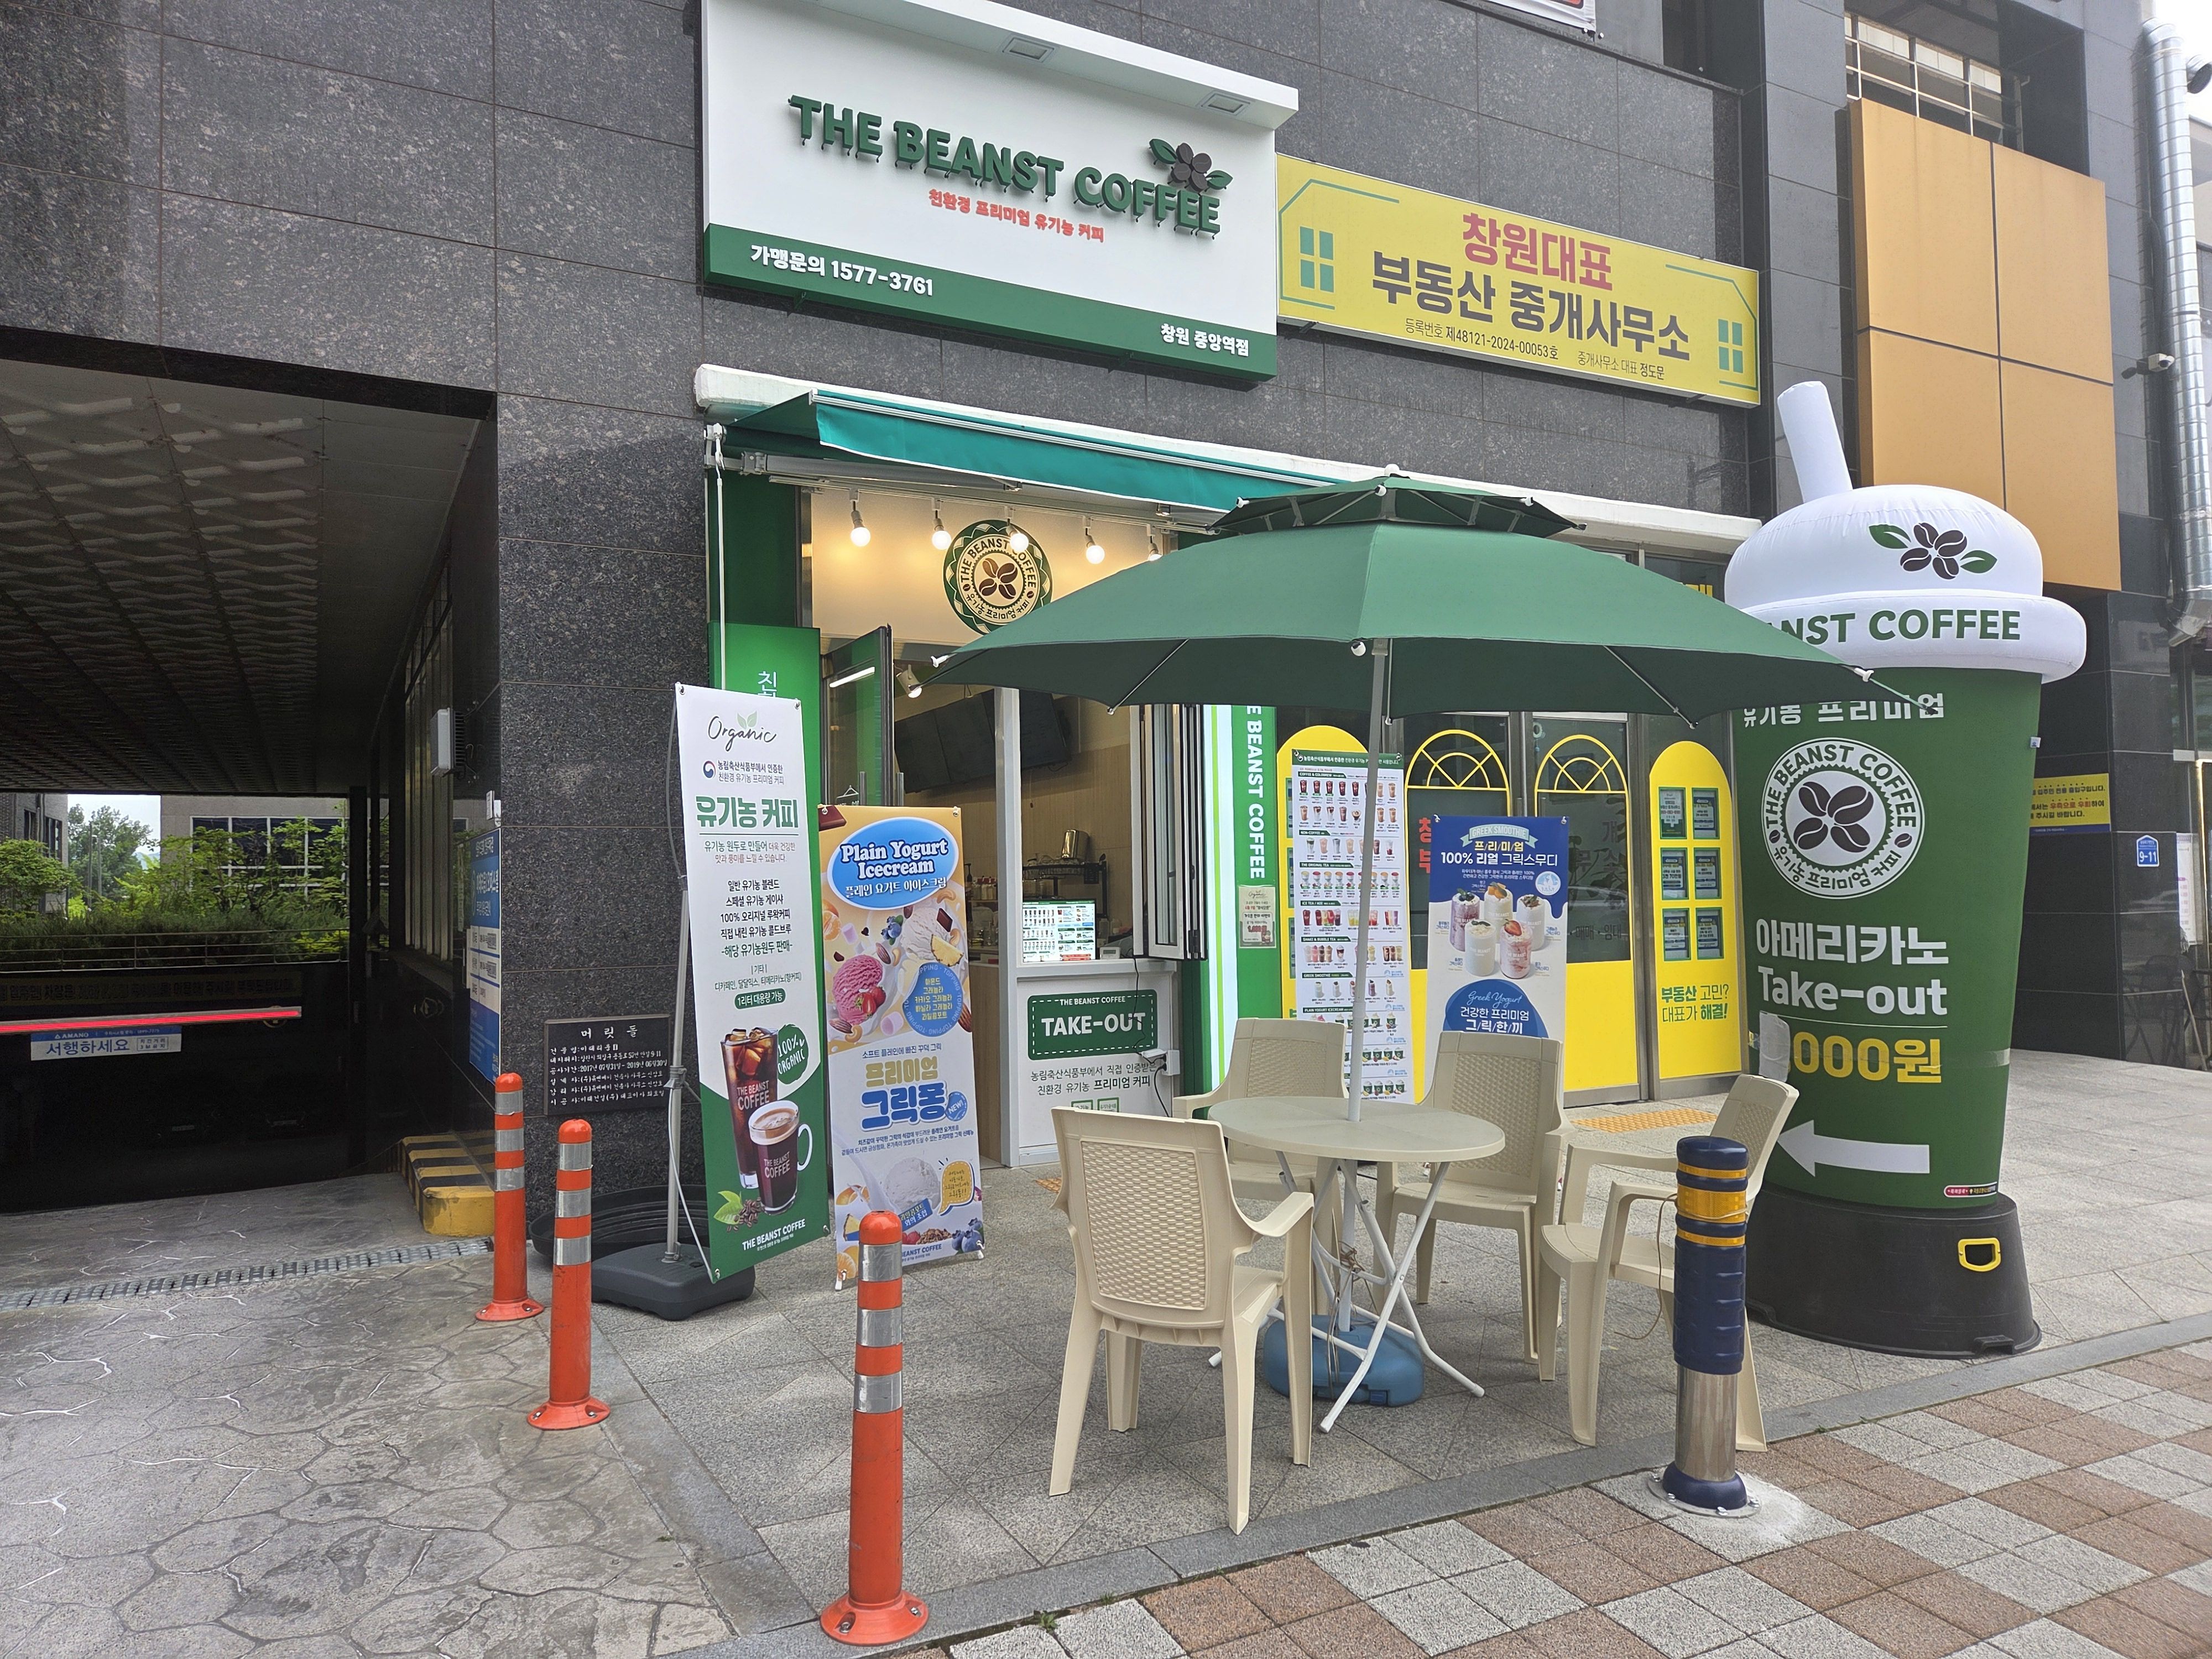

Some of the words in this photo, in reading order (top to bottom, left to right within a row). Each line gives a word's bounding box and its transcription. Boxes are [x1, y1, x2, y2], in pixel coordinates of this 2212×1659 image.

[788, 95, 882, 157] THE
[894, 121, 1063, 196] BEANST
[1074, 167, 1220, 234] COFFEE
[929, 189, 971, 213] 친환경
[976, 200, 1030, 227] 프리미엄
[1078, 223, 1104, 242] 커피
[1463, 212, 1613, 291] 창원대표
[751, 244, 826, 276] 가맹문의
[831, 260, 933, 298] 1577-3761
[1372, 251, 1495, 322] 부동산
[1509, 280, 1689, 361] 중개사무소
[1160, 323, 1190, 345] 창원
[1194, 329, 1249, 357] 중앙역점
[1405, 318, 1443, 338] 등록번호
[1446, 326, 1558, 360] 제48121-2024-00053호
[1578, 351, 1619, 371] 중개사무소
[1621, 360, 1637, 374] 대표
[1640, 363, 1665, 379] 정도문
[961, 558, 972, 583] THE
[968, 538, 1010, 559] BEANST
[966, 593, 985, 614] 유기농
[985, 610, 1016, 619] 프리미엄
[1016, 600, 1029, 613] 커피
[1869, 609, 2020, 640] COFFEE
[708, 716, 776, 752] Organic
[718, 761, 765, 773] 농림축산식품부에서
[768, 764, 783, 774] 인증한
[1247, 720, 1263, 798] BEANST
[1773, 744, 1854, 786] BEANST
[718, 774, 734, 782] 친환경
[736, 775, 751, 783] 유기농
[753, 775, 773, 784] 프리미엄
[774, 776, 784, 785] 커피
[2069, 785, 2105, 794] 출입구입니다.
[1859, 754, 1916, 827] COFFEE
[696, 796, 757, 827] 유기농
[761, 799, 799, 828] 커피
[1766, 787, 1781, 829] THE
[1249, 802, 1265, 879] COFFEE
[1472, 826, 1493, 837] GREEK
[1494, 826, 1526, 837] SMOOTHIE
[704, 841, 725, 852] 유기농
[727, 841, 747, 852] 원두로
[748, 841, 768, 852] 만들어
[841, 843, 887, 863] Plain
[890, 838, 948, 862] Yogurt
[1475, 841, 1524, 852] 프/리/미/엄
[1441, 852, 1473, 864] 100%
[1477, 853, 1498, 864] 리얼
[1501, 854, 1558, 866] 그릭스무디
[1773, 846, 1804, 882] 유기농
[1806, 868, 1871, 889] 프리미엄
[1871, 850, 1901, 875] 커피
[2140, 852, 2157, 863] 9-11
[858, 859, 935, 879] Icecream
[728, 880, 740, 891] 일반
[742, 880, 760, 891] 유기농
[762, 879, 780, 890] 블렌드
[845, 885, 872, 898] 플레인
[875, 882, 901, 894] 요거트
[904, 877, 946, 891] 아이스크림
[726, 896, 744, 907] 스페셜
[747, 895, 764, 906] 유기농
[766, 894, 783, 905] 게이샤
[721, 912, 740, 922] 100%
[742, 911, 765, 921] 오리지널
[767, 909, 790, 920] 루왁커피
[721, 928, 733, 940] 직접
[735, 927, 747, 938] 내린
[749, 926, 766, 937] 유기농
[769, 924, 791, 936] 콜드브루
[1756, 919, 1949, 964] 아메리카노
[741, 941, 775, 957] 유기농원두
[738, 995, 753, 1006] 1리터
[754, 993, 770, 1004] 대용량
[771, 991, 782, 1002] 가능
[1468, 991, 1491, 1005] Greek
[1662, 985, 1697, 1003] 부동산
[1700, 984, 1729, 1000] 고민?
[1758, 966, 1948, 1015] Take-out
[1460, 1008, 1489, 1018] 건강한
[1491, 1009, 1528, 1021] 프리미엄
[1663, 1005, 1697, 1022] 대표가
[1700, 1003, 1728, 1020] 해결!
[1041, 1013, 1145, 1036] TAKE-OUT
[1466, 1020, 1523, 1034] 그/릭/한/끼
[46, 1039, 129, 1056] 서행하세요
[862, 1051, 880, 1059] 소프트
[1789, 1031, 1942, 1083] 000원
[778, 1048, 806, 1075] ORGANIC
[865, 1056, 938, 1087] 프리미엄
[1031, 1066, 1103, 1081] 농림축산식품부에서
[1107, 1064, 1122, 1075] 직접
[1126, 1063, 1156, 1074] 인증받은
[737, 1086, 748, 1096] THE
[749, 1080, 770, 1094] BEANST
[1037, 1084, 1062, 1095] 친환경
[1066, 1081, 1090, 1093] 유기농
[1093, 1077, 1130, 1090] 프리미엄
[1133, 1075, 1150, 1088] 커피
[737, 1091, 770, 1110] COFFEE
[861, 1082, 946, 1129] 그릭퐁
[948, 1100, 963, 1115] NEW!
[764, 1158, 773, 1167] THE
[773, 1151, 790, 1166] BEANST
[764, 1161, 790, 1178] COFFEE
[742, 1238, 755, 1250] THE
[757, 1228, 781, 1245] BEANST
[782, 1219, 805, 1234] COFFEE
[922, 1244, 942, 1253] COFFEE
